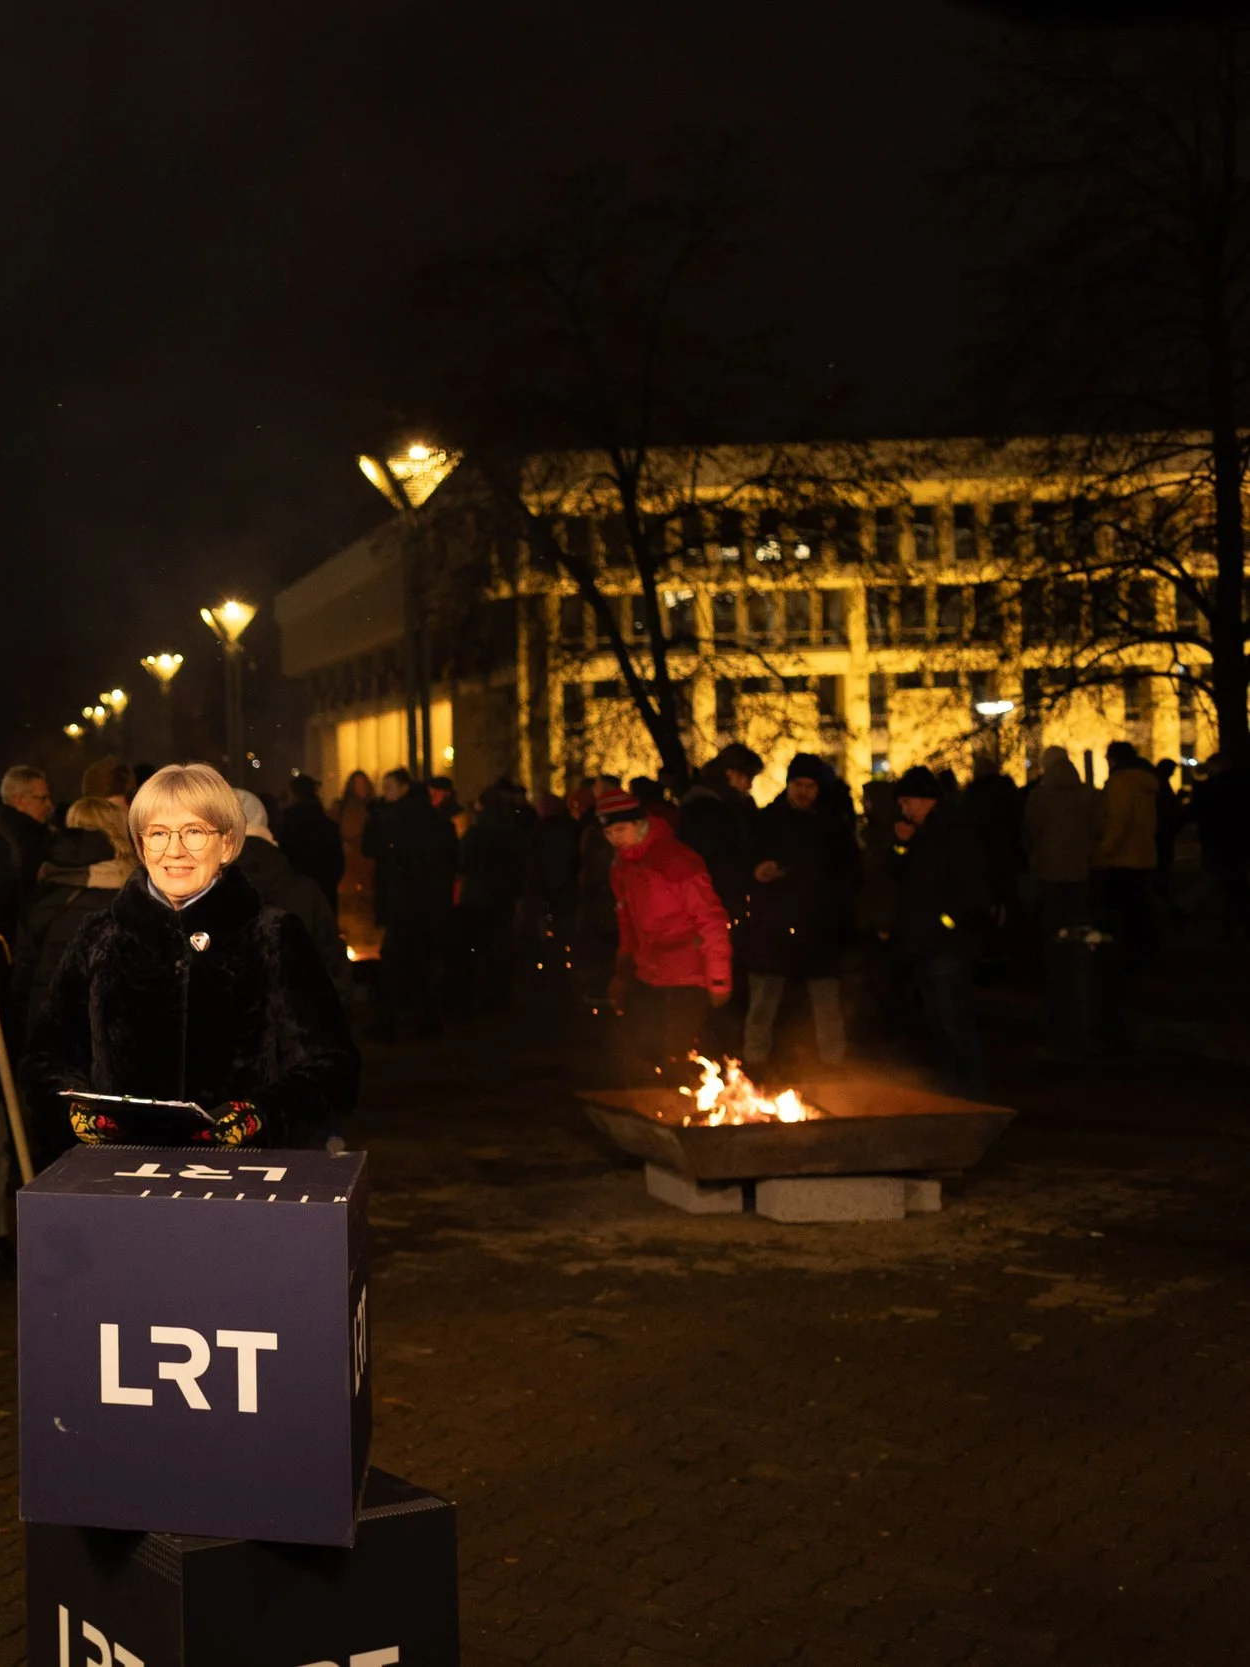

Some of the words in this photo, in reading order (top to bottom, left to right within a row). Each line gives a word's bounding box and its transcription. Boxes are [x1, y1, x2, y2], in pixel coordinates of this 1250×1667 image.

[113, 1163, 288, 1182] LRT
[100, 1323, 278, 1413] LRT
[353, 1283, 367, 1398] LRT
